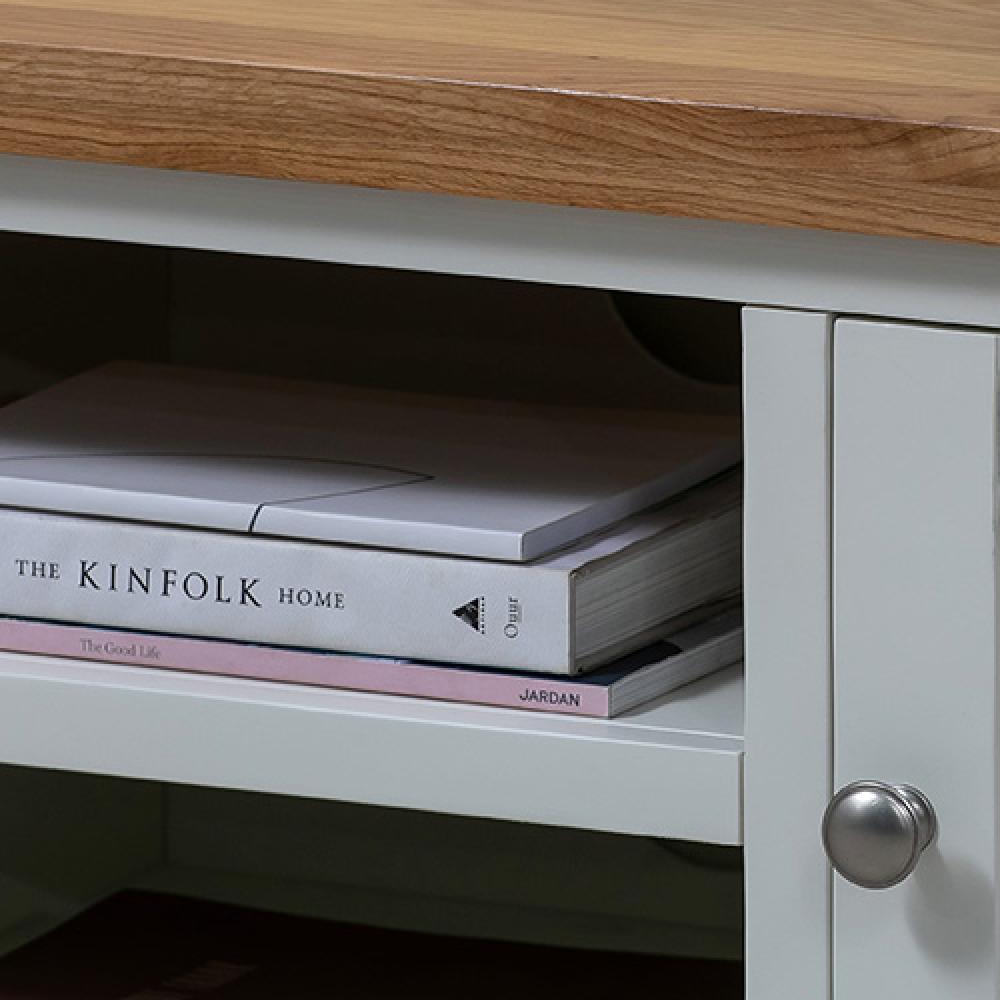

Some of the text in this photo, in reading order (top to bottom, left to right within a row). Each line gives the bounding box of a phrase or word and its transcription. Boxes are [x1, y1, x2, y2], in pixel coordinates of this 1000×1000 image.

[15, 559, 345, 610] THE KINFOLK HOME
[80, 638, 161, 659] The Good Life
[519, 688, 580, 707] JARDAN
